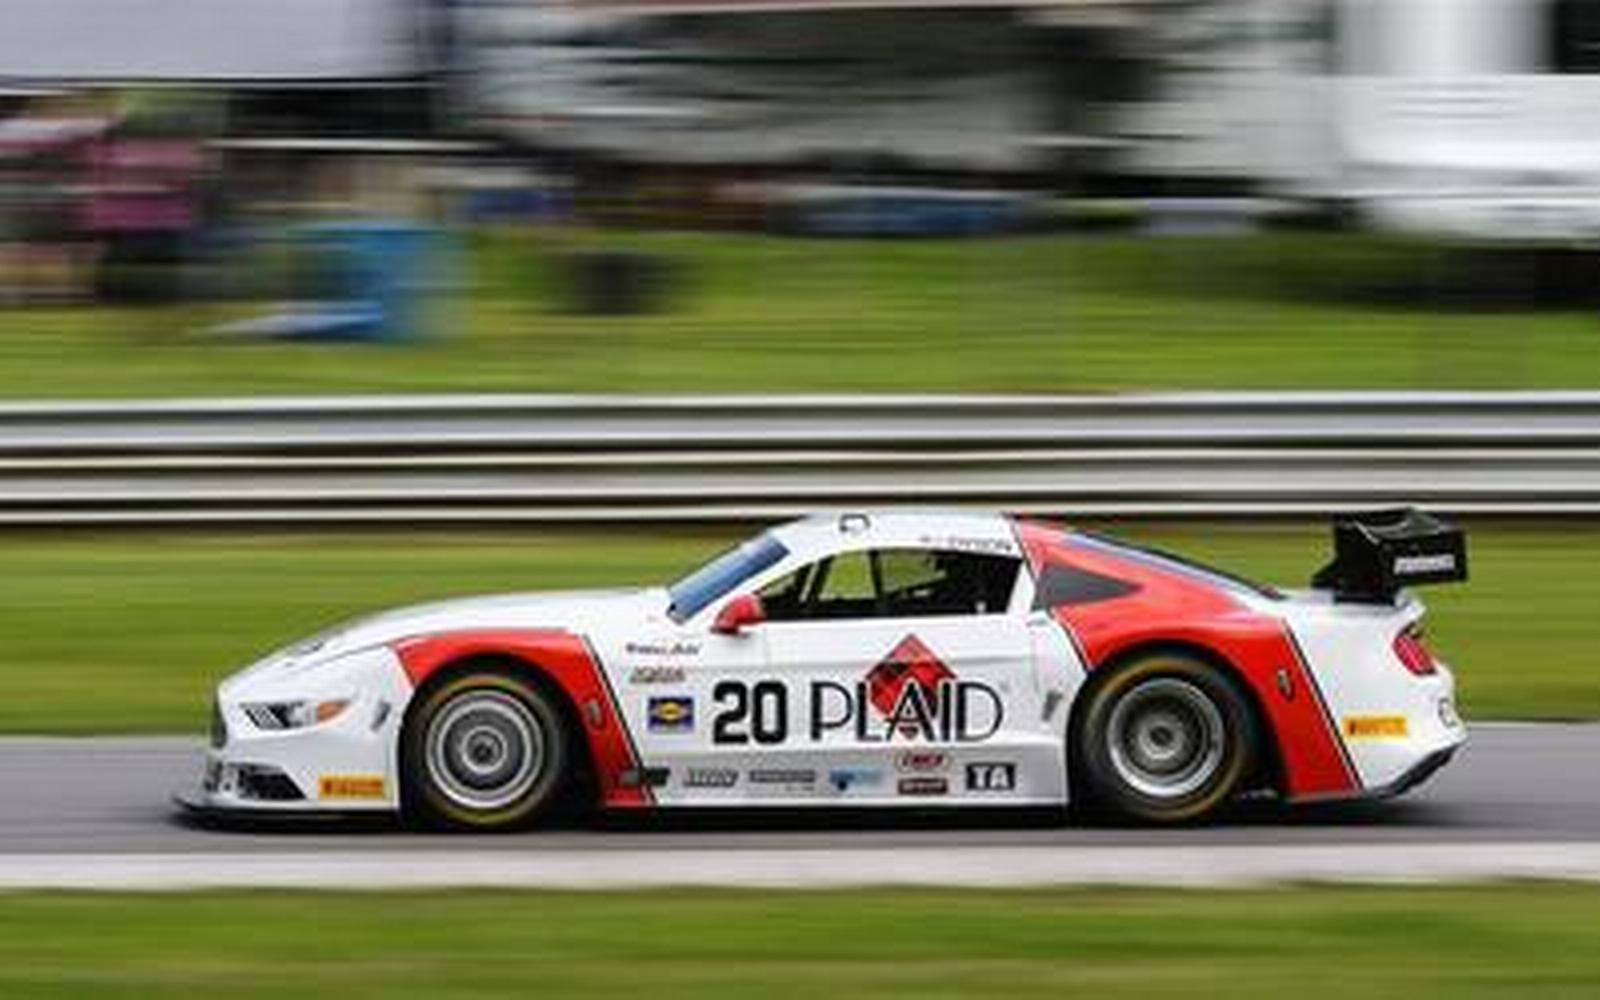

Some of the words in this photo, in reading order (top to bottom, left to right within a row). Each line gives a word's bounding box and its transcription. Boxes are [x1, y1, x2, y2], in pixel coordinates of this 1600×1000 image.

[713, 681, 787, 744] 20
[811, 681, 1003, 741] PLAID
[972, 766, 1011, 788] TA
